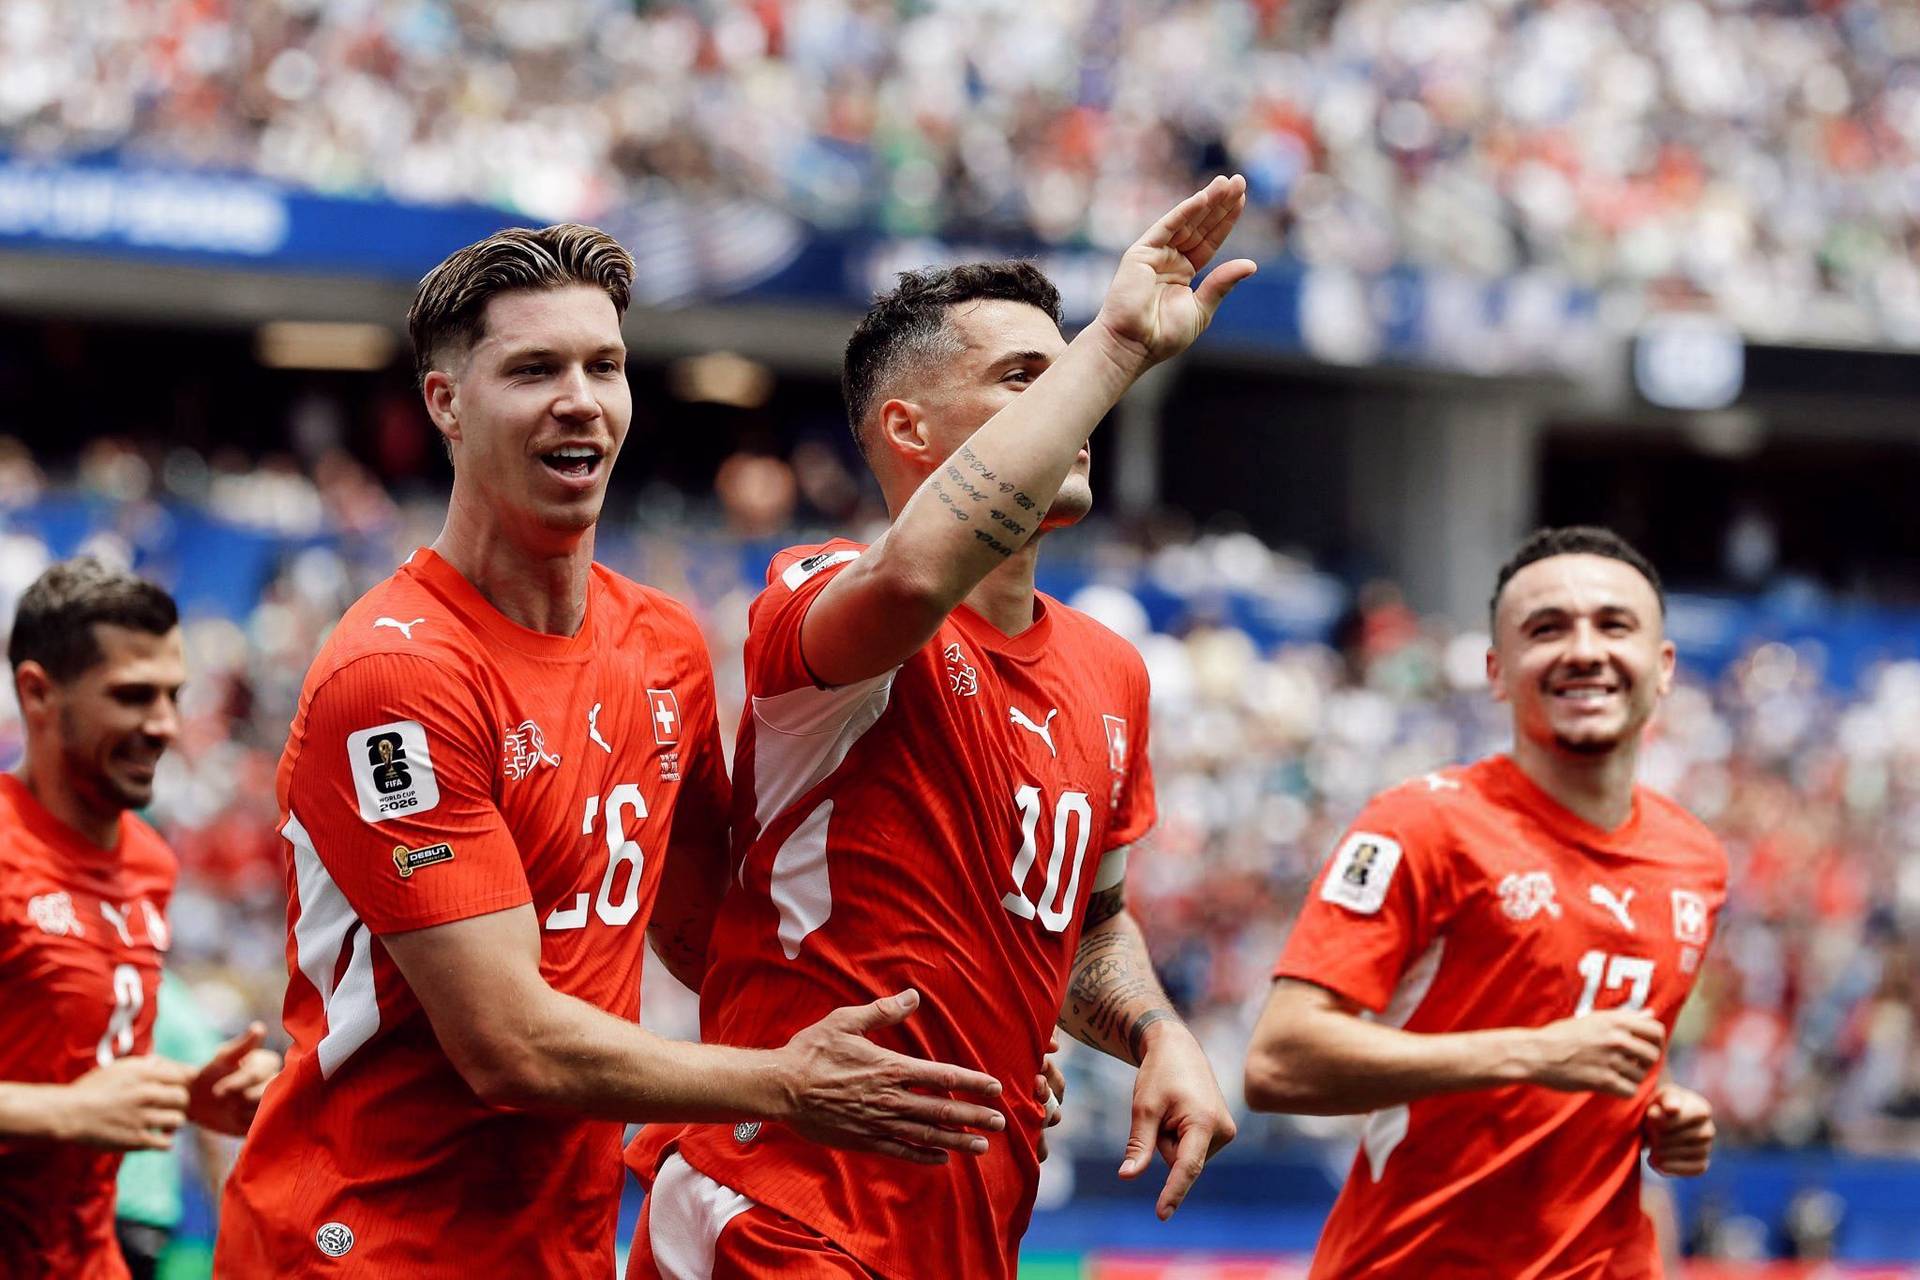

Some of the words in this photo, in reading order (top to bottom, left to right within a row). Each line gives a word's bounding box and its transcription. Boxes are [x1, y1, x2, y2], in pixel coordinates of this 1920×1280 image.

[385, 778, 403, 789] FIFA
[379, 793, 402, 803] WORLD
[403, 790, 416, 799] CUP
[379, 797, 418, 813] 2026
[409, 846, 447, 861] DEBUT
[1001, 784, 1093, 933] 10
[1574, 950, 1656, 1018] 17
